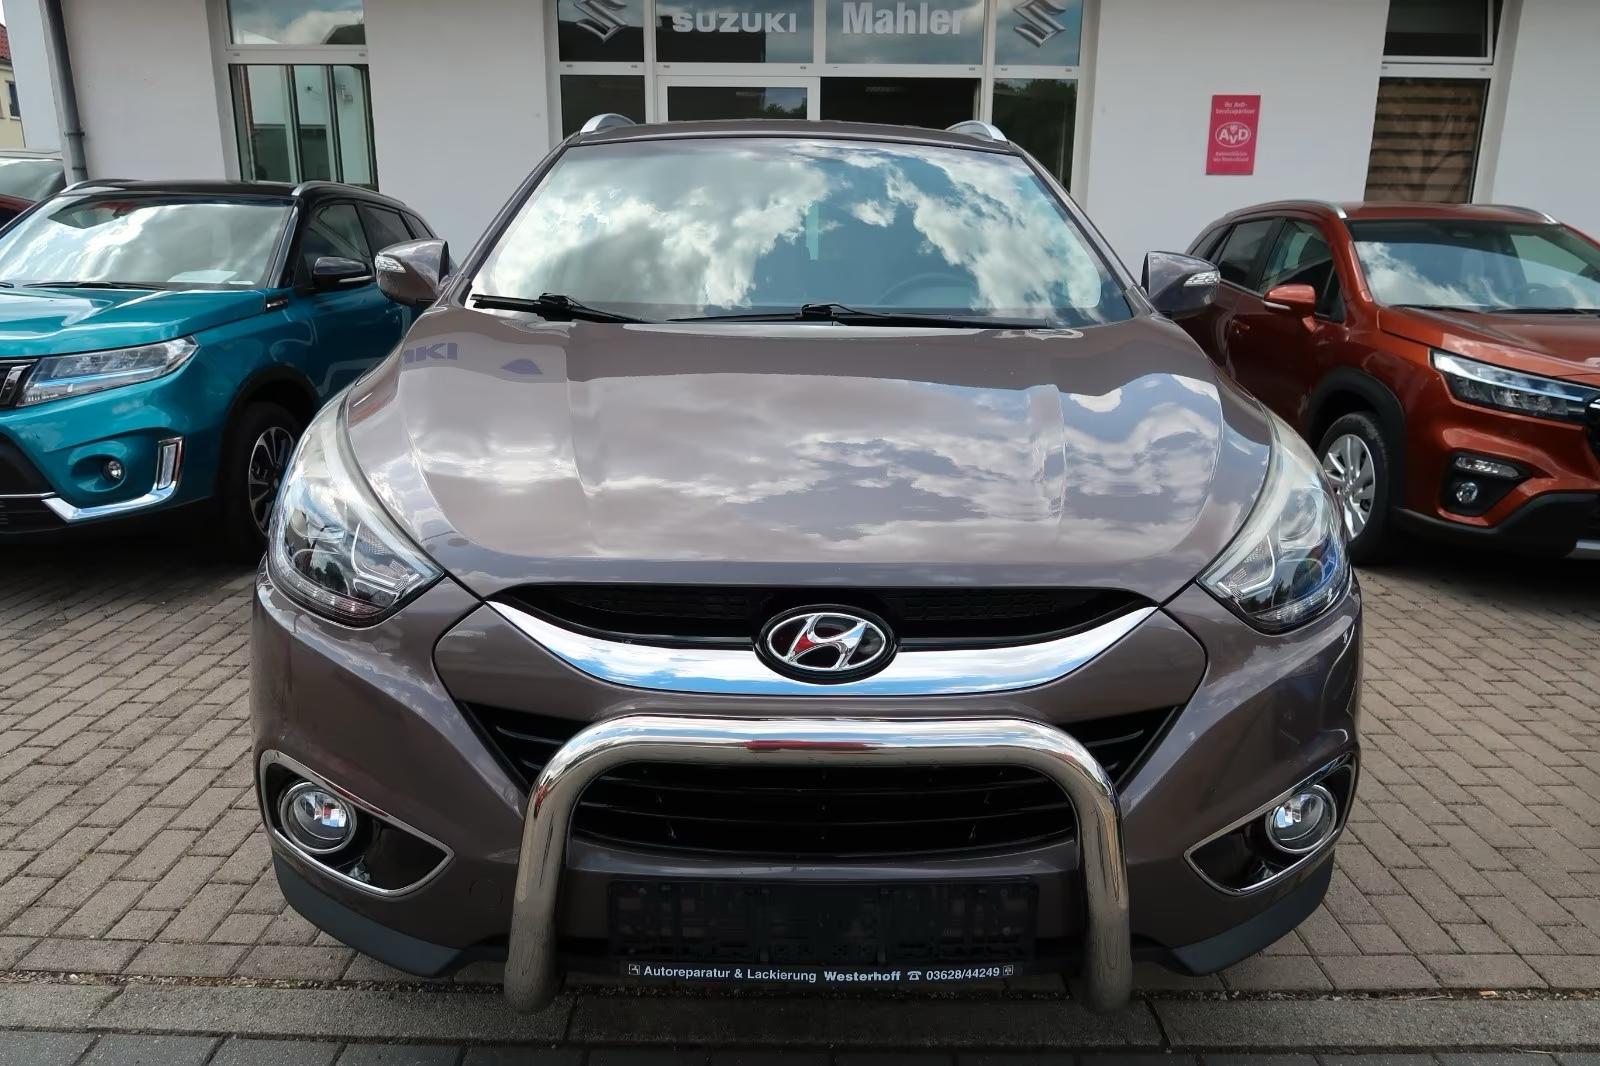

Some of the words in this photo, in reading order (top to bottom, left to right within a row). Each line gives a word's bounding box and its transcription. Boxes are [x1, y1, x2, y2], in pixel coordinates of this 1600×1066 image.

[672, 11, 797, 33] SUZUKI
[842, 1, 964, 35] Mahler
[643, 965, 730, 979] Autoreparatur
[734, 968, 743, 979] &
[747, 968, 817, 983] Lackierung
[824, 970, 901, 982] Westerhoff
[926, 967, 1000, 981] 03628/44249
